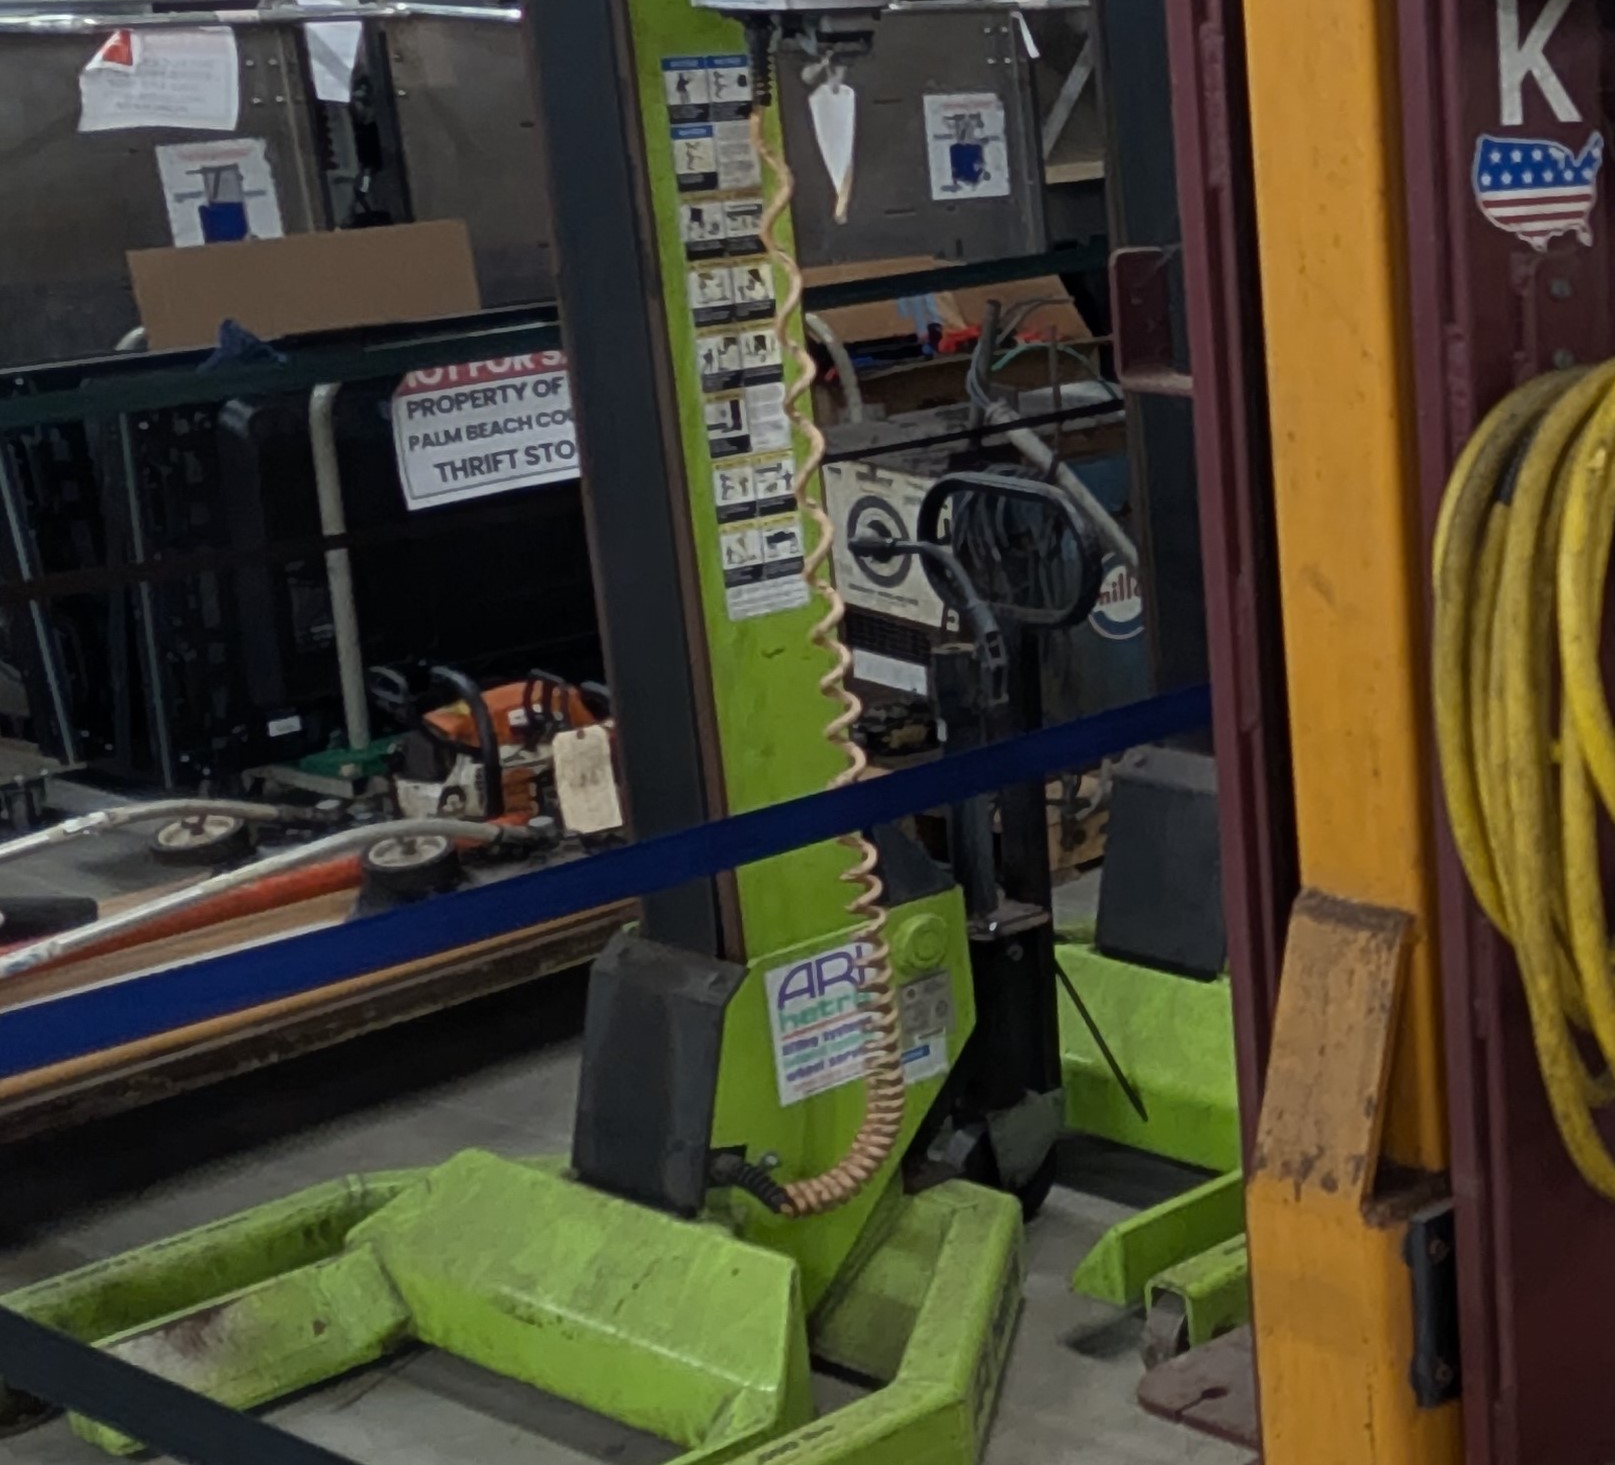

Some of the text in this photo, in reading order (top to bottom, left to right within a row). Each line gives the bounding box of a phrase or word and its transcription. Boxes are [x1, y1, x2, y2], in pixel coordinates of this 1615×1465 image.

[406, 376, 564, 421] PROPERTY OF
[408, 427, 463, 452] PALM
[465, 414, 534, 442] BEACH
[433, 448, 519, 484] THRIFT
